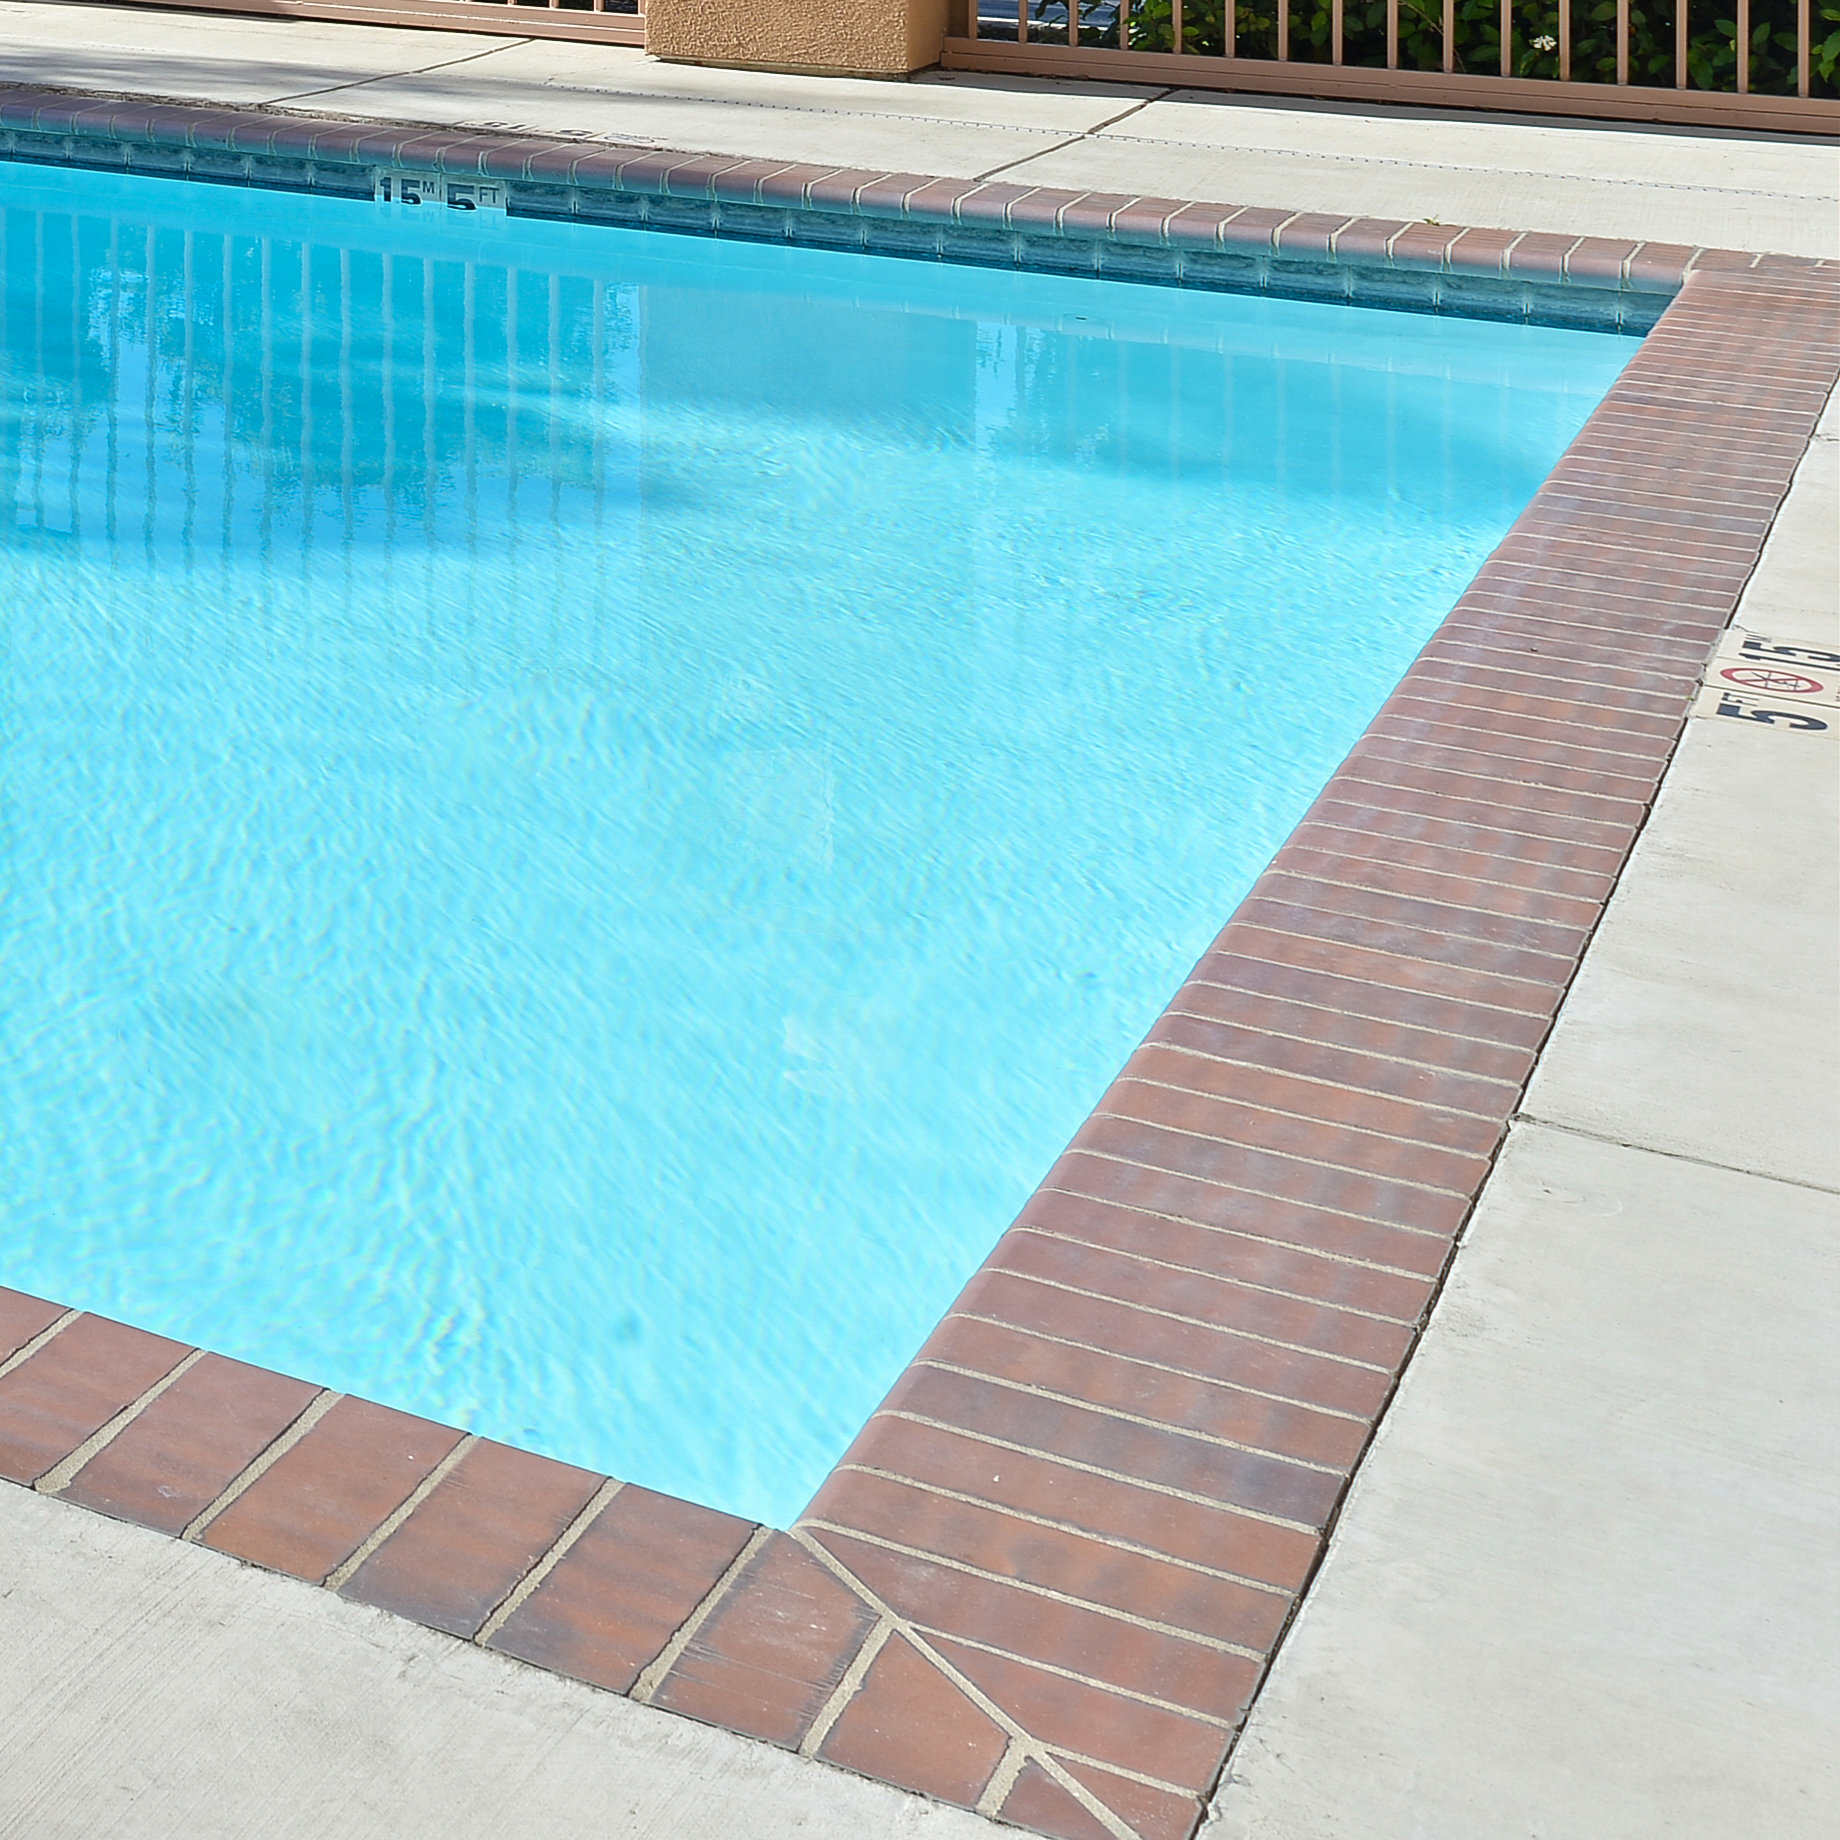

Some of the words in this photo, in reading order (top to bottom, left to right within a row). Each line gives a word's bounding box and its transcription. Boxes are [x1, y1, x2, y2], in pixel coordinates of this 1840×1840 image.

[422, 180, 435, 194] M
[447, 182, 477, 211] 5
[478, 186, 500, 204] FT
[1720, 692, 1760, 707] FT
[1716, 702, 1828, 731] 5
